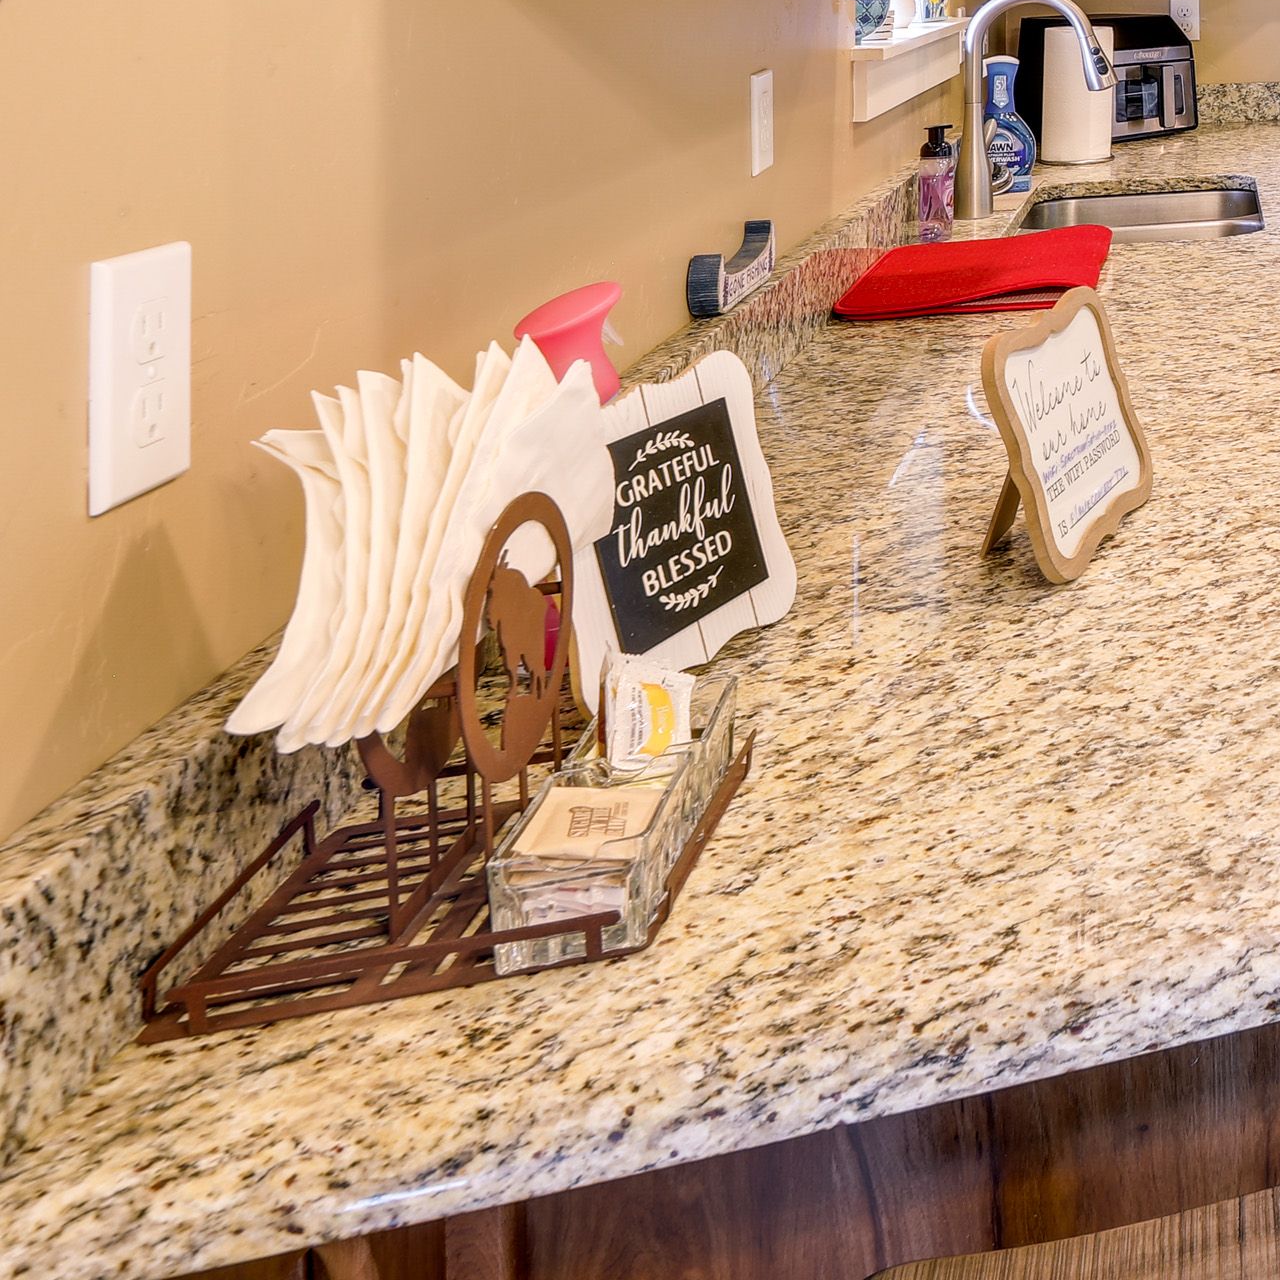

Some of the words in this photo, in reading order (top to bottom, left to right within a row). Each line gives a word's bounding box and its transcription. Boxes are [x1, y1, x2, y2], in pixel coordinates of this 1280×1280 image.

[989, 143, 1013, 152] AWN
[729, 272, 745, 298] GONE
[1012, 359, 1083, 433] Welcome
[1080, 348, 1101, 383] to
[1042, 430, 1067, 461] our
[1068, 401, 1107, 437] home
[616, 444, 719, 508] GRATEFUL
[1046, 477, 1067, 503] THE
[1064, 460, 1085, 487] WIFI
[1083, 429, 1121, 471] PASSWORD
[612, 463, 736, 568] thankful
[1057, 519, 1069, 539] IS
[641, 530, 733, 598] BLESSED
